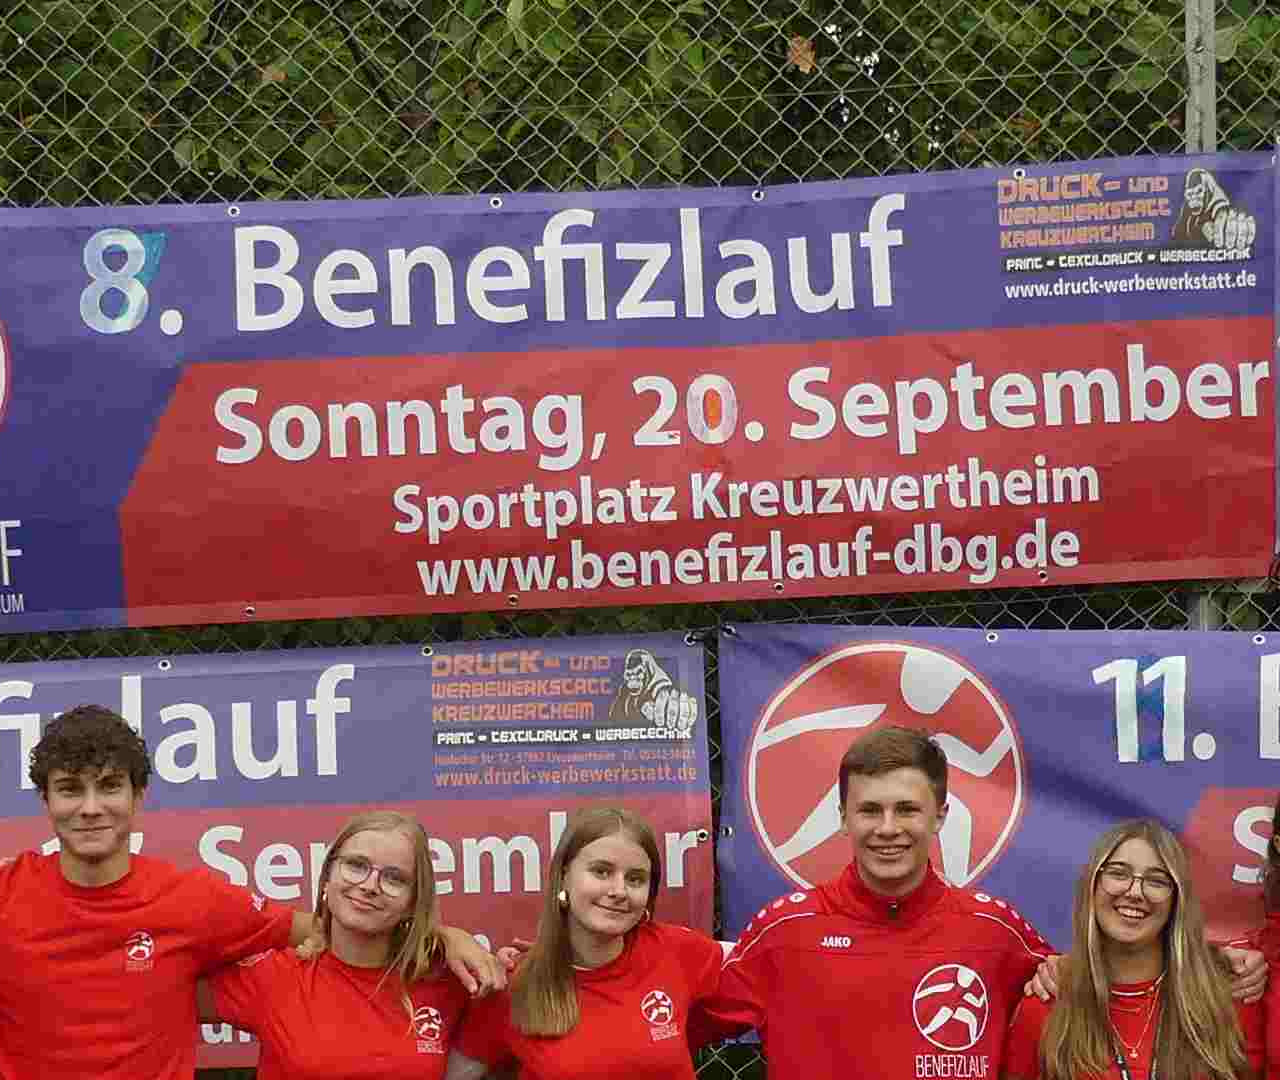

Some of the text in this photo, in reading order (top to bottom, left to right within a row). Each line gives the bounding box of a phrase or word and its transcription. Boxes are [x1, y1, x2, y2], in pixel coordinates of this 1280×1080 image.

[79, 192, 906, 336] 8. Benefizlauf
[1004, 270, 1257, 299] www.druck-werbewerkstatt.de
[214, 343, 1270, 471] Sonntag, 20. September
[393, 455, 1100, 548] Sportplatz Kreuzwertheim
[416, 517, 1080, 596] www.benefizlauf-dbg.de
[1091, 655, 1218, 763] 11.
[821, 936, 852, 948] JAKO
[915, 1055, 990, 1079] BENEFIZLAUF
